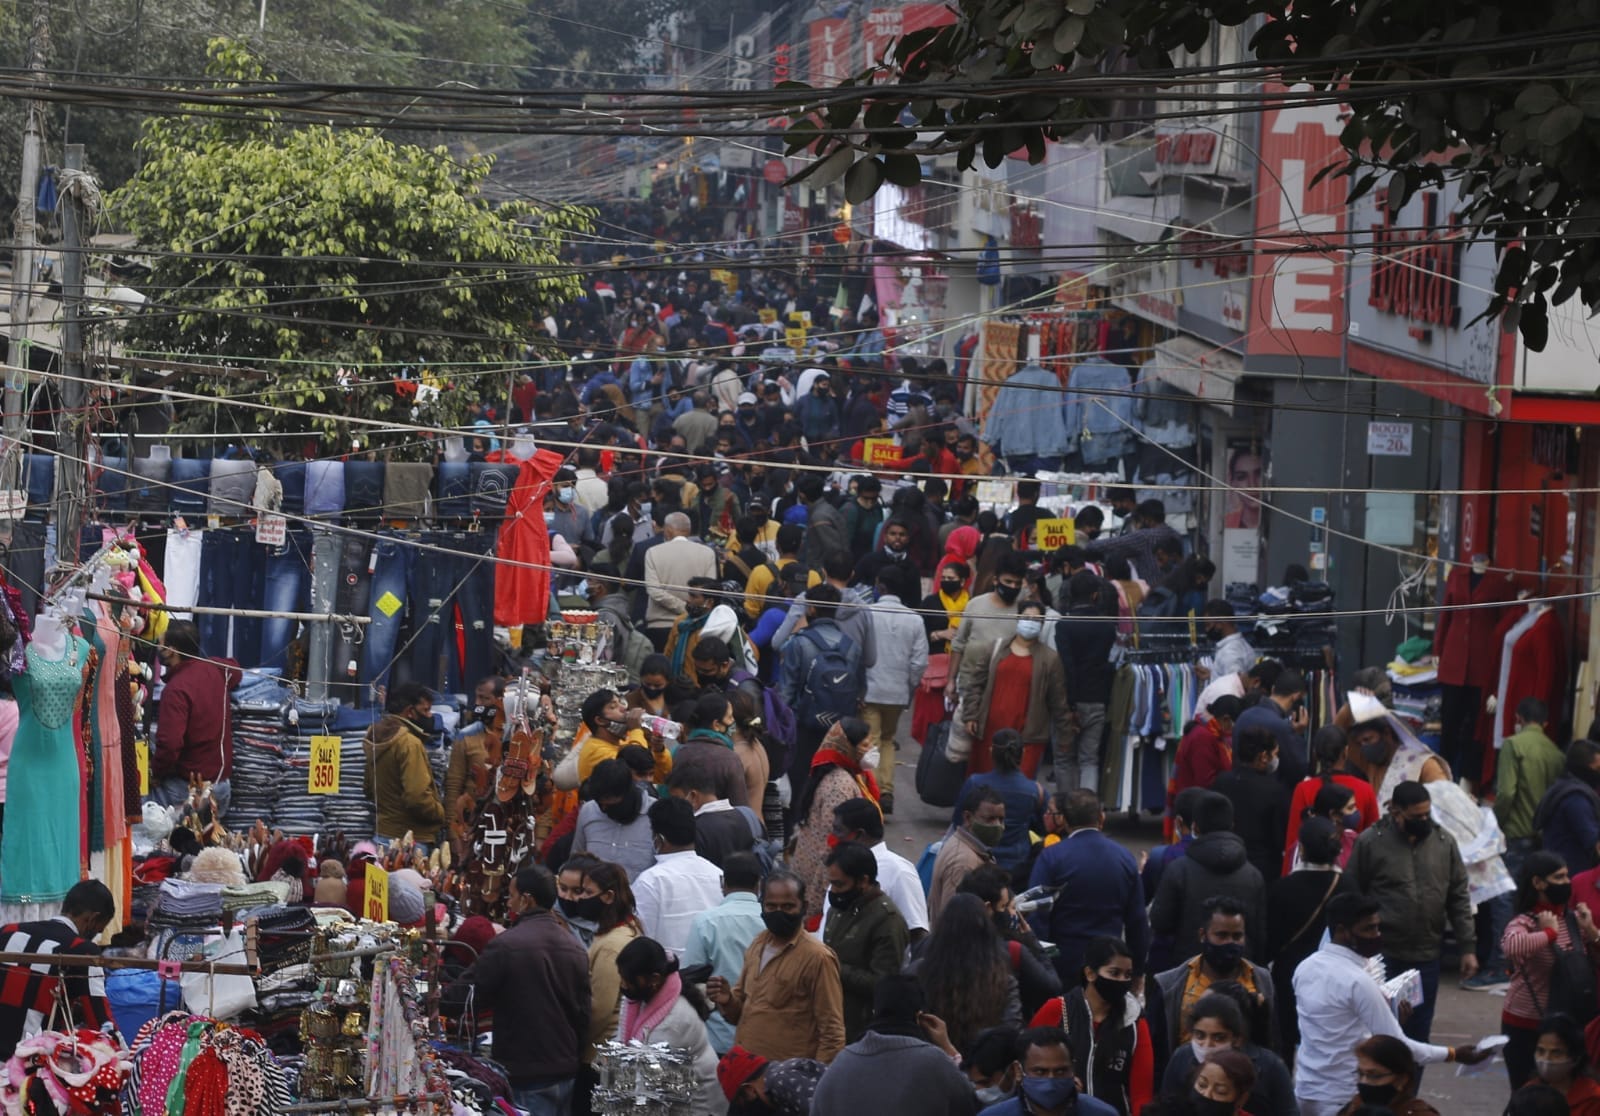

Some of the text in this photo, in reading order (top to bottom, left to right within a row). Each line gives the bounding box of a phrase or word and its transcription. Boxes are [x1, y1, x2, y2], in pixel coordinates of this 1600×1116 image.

[873, 449, 901, 460] SALE
[1047, 525, 1064, 534] SALE
[1043, 535, 1067, 548] 100
[319, 748, 332, 763] SALE
[314, 764, 334, 788] 350
[371, 879, 382, 899] SALE
